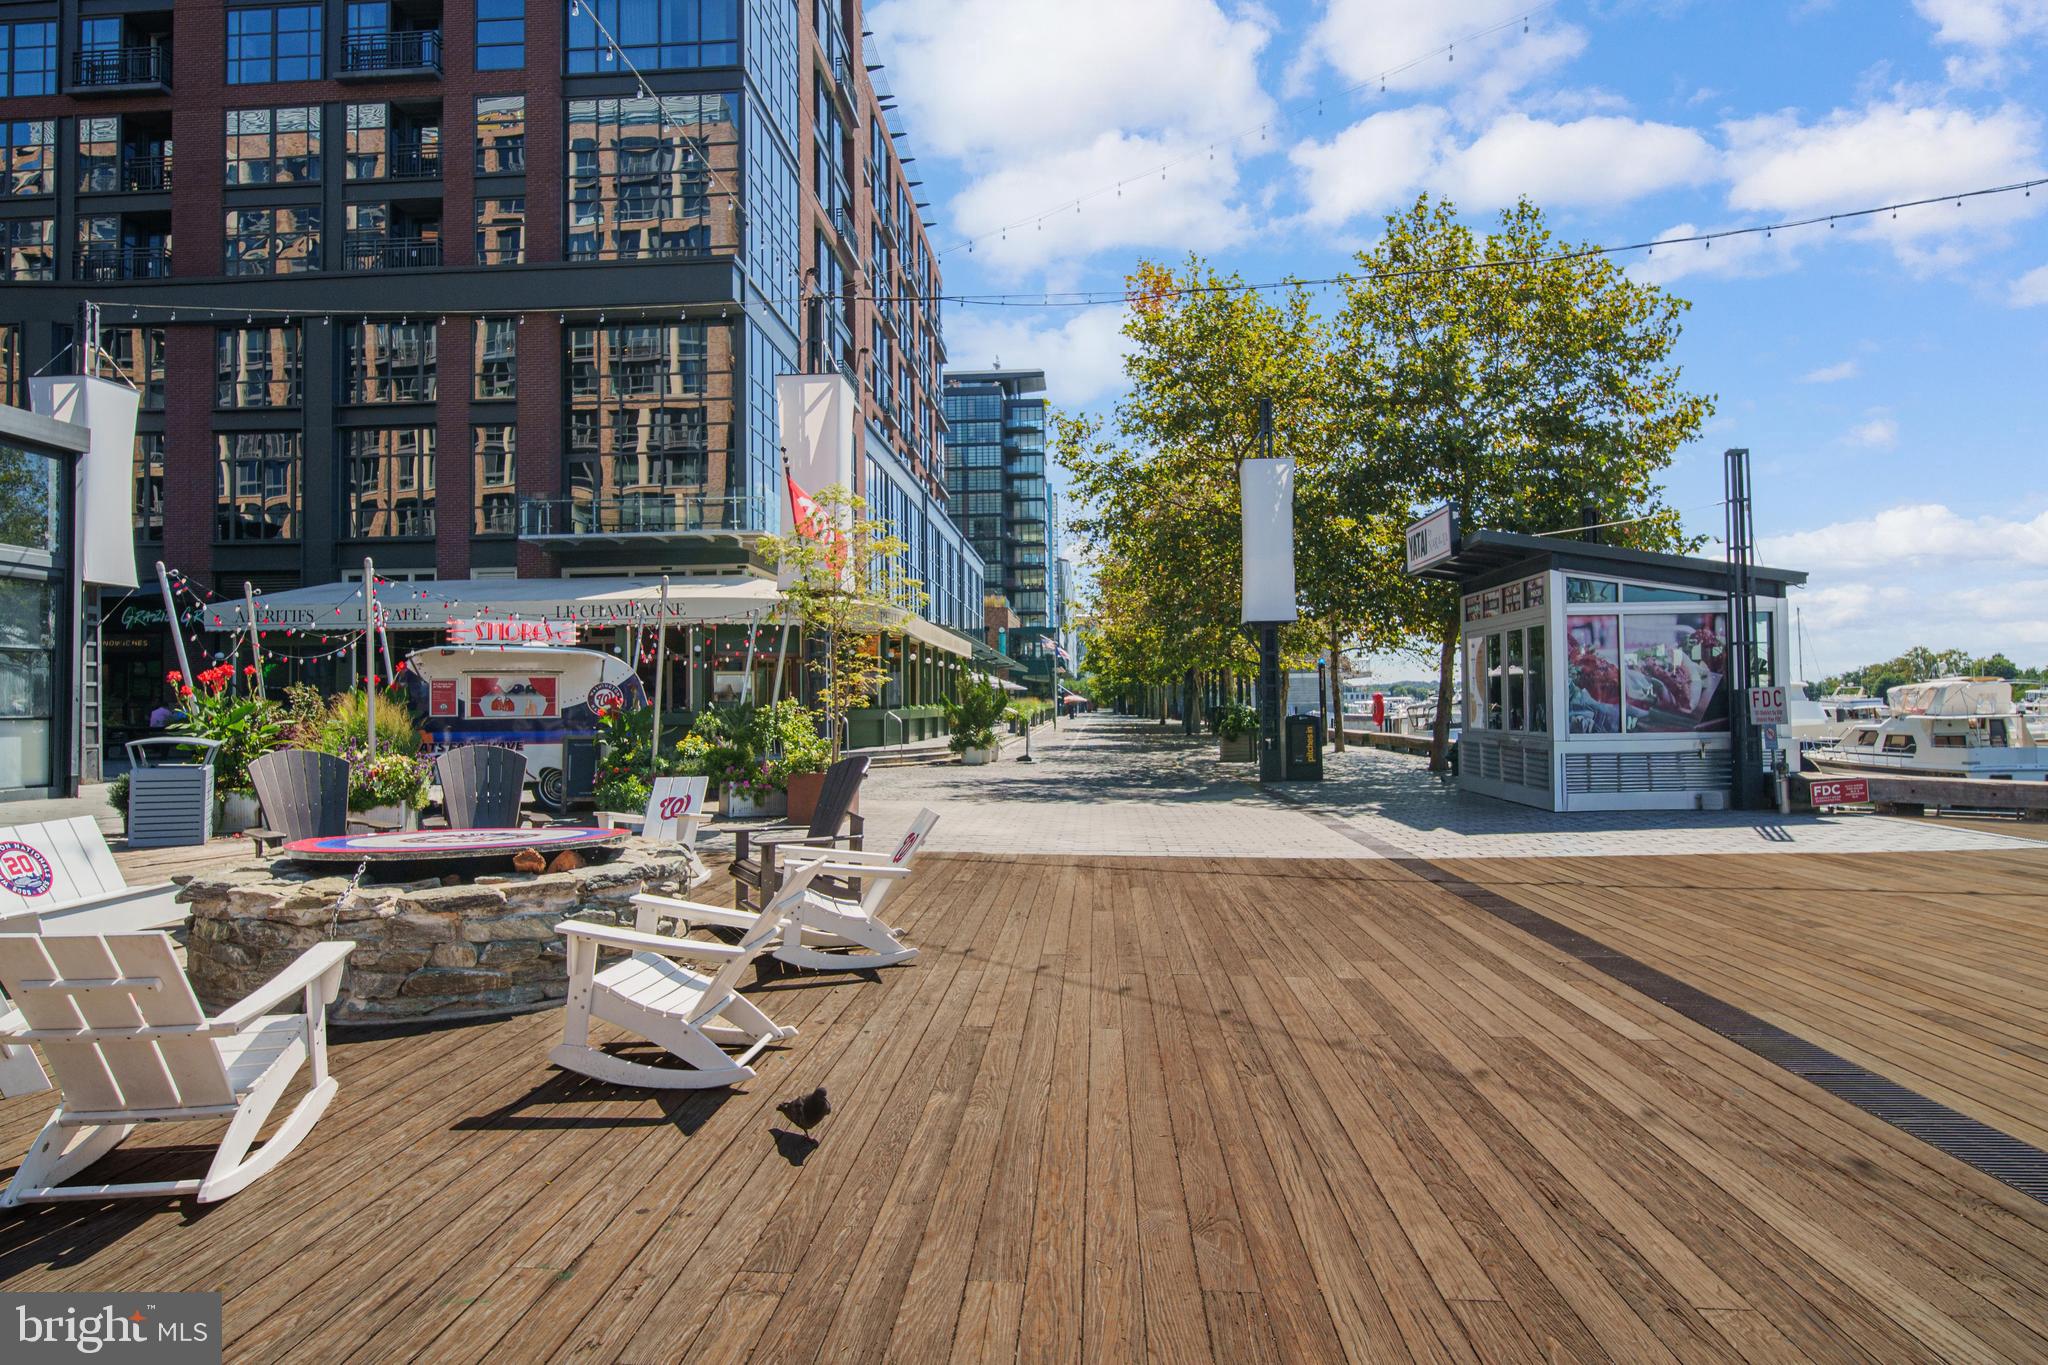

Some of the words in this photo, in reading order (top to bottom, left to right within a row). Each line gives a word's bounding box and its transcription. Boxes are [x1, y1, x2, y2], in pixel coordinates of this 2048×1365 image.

[1408, 528, 1428, 562] YATAI
[233, 607, 314, 623] AÉRITIFS
[556, 604, 576, 618] LE
[1752, 689, 1782, 708] FDC
[1813, 784, 1841, 797] FDC
[3, 855, 35, 875] 20
[14, 843, 51, 878] NATIONALS
